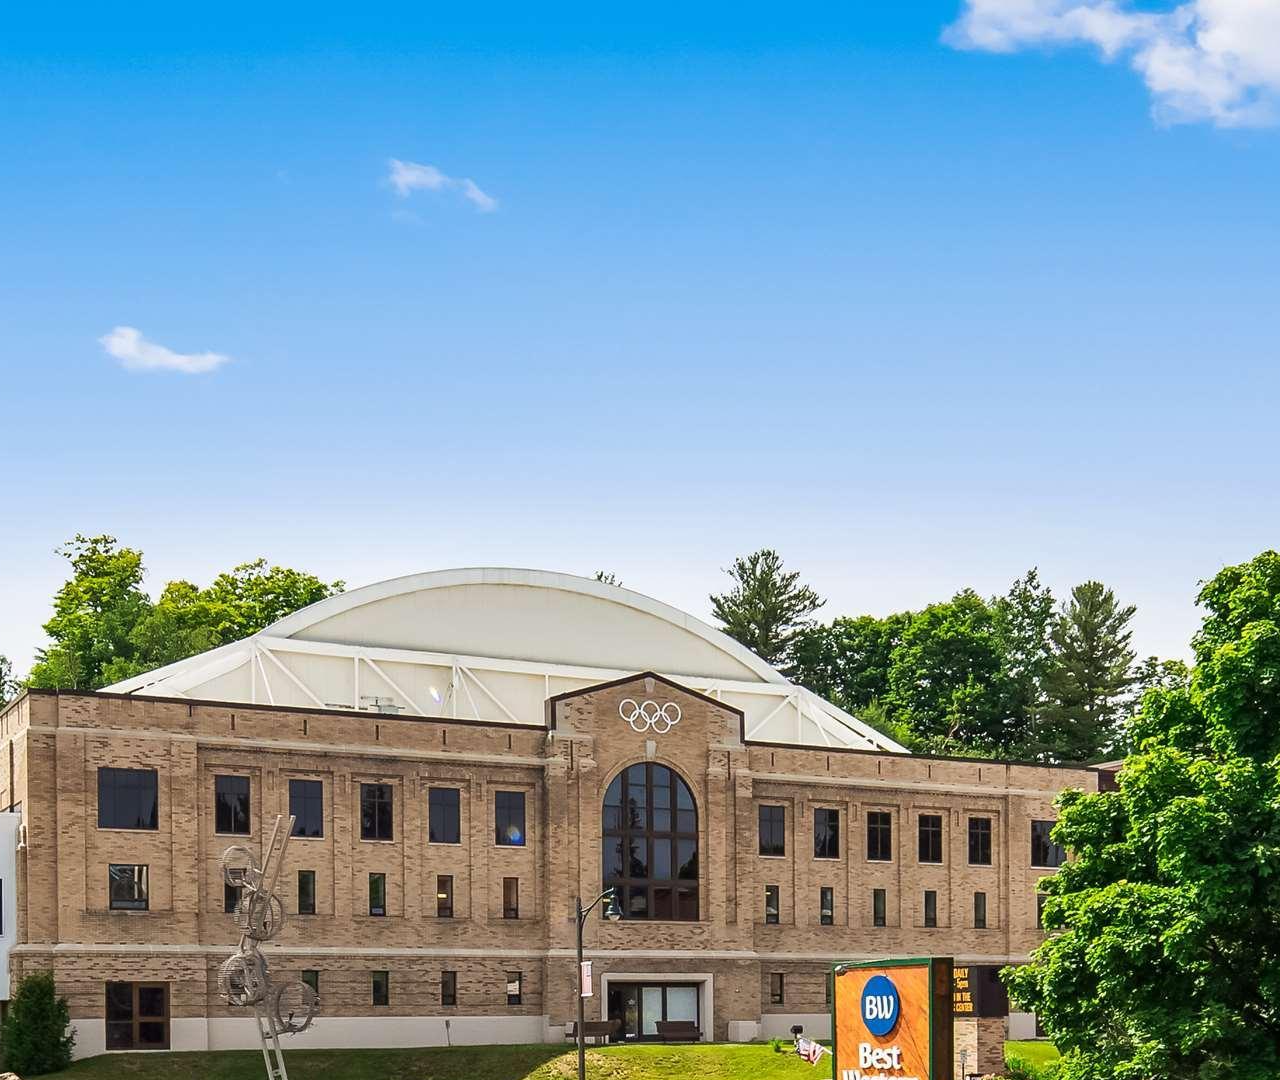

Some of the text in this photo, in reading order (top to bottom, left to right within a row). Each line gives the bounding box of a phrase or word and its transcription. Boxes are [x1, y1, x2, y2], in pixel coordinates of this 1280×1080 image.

[953, 968, 969, 978] DAILY
[962, 992, 971, 1002] THE
[865, 996, 894, 1020] BW
[956, 1002, 973, 1011] CENTER
[858, 1043, 902, 1070] Best
